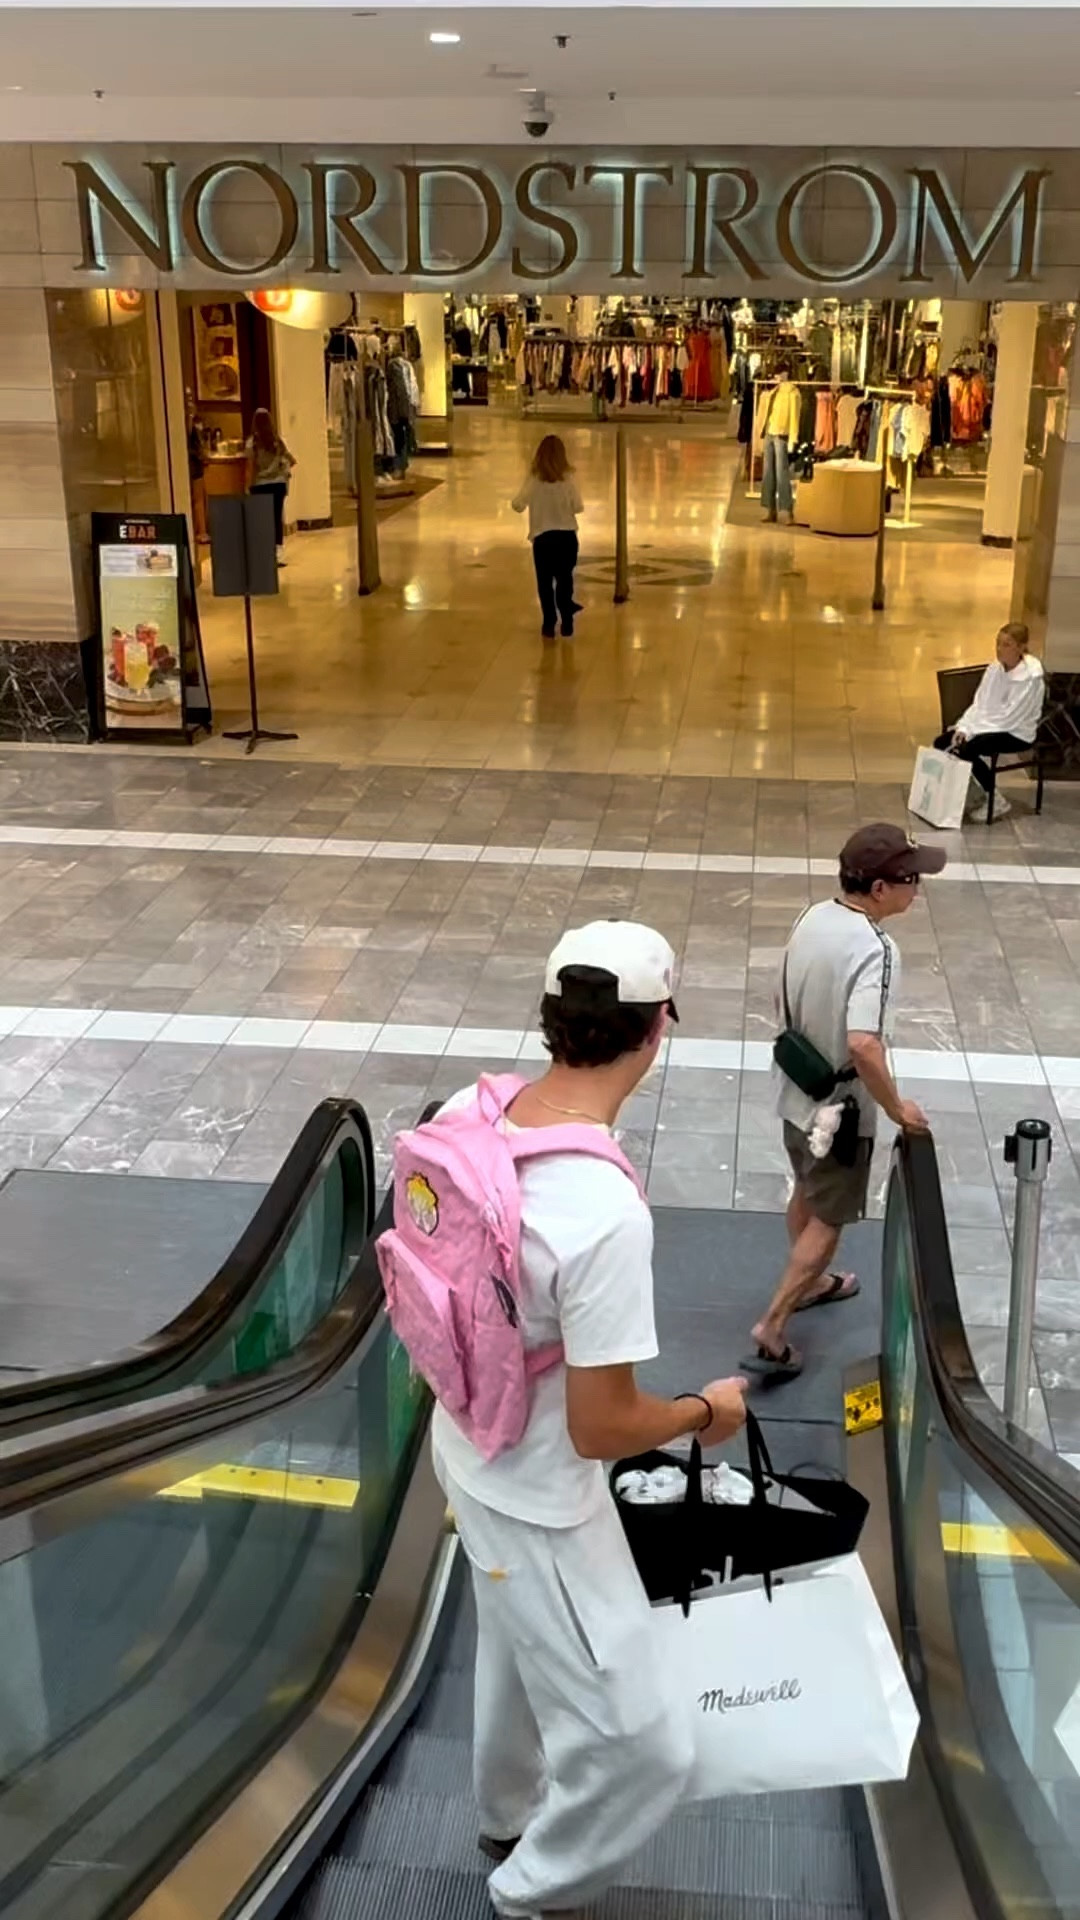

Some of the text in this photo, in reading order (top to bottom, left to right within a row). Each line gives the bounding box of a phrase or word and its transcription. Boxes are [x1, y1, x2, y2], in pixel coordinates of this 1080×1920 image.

[63, 160, 1053, 283] NORDSTROM
[119, 525, 156, 539] EBAR
[698, 1678, 802, 1714] Madewell
